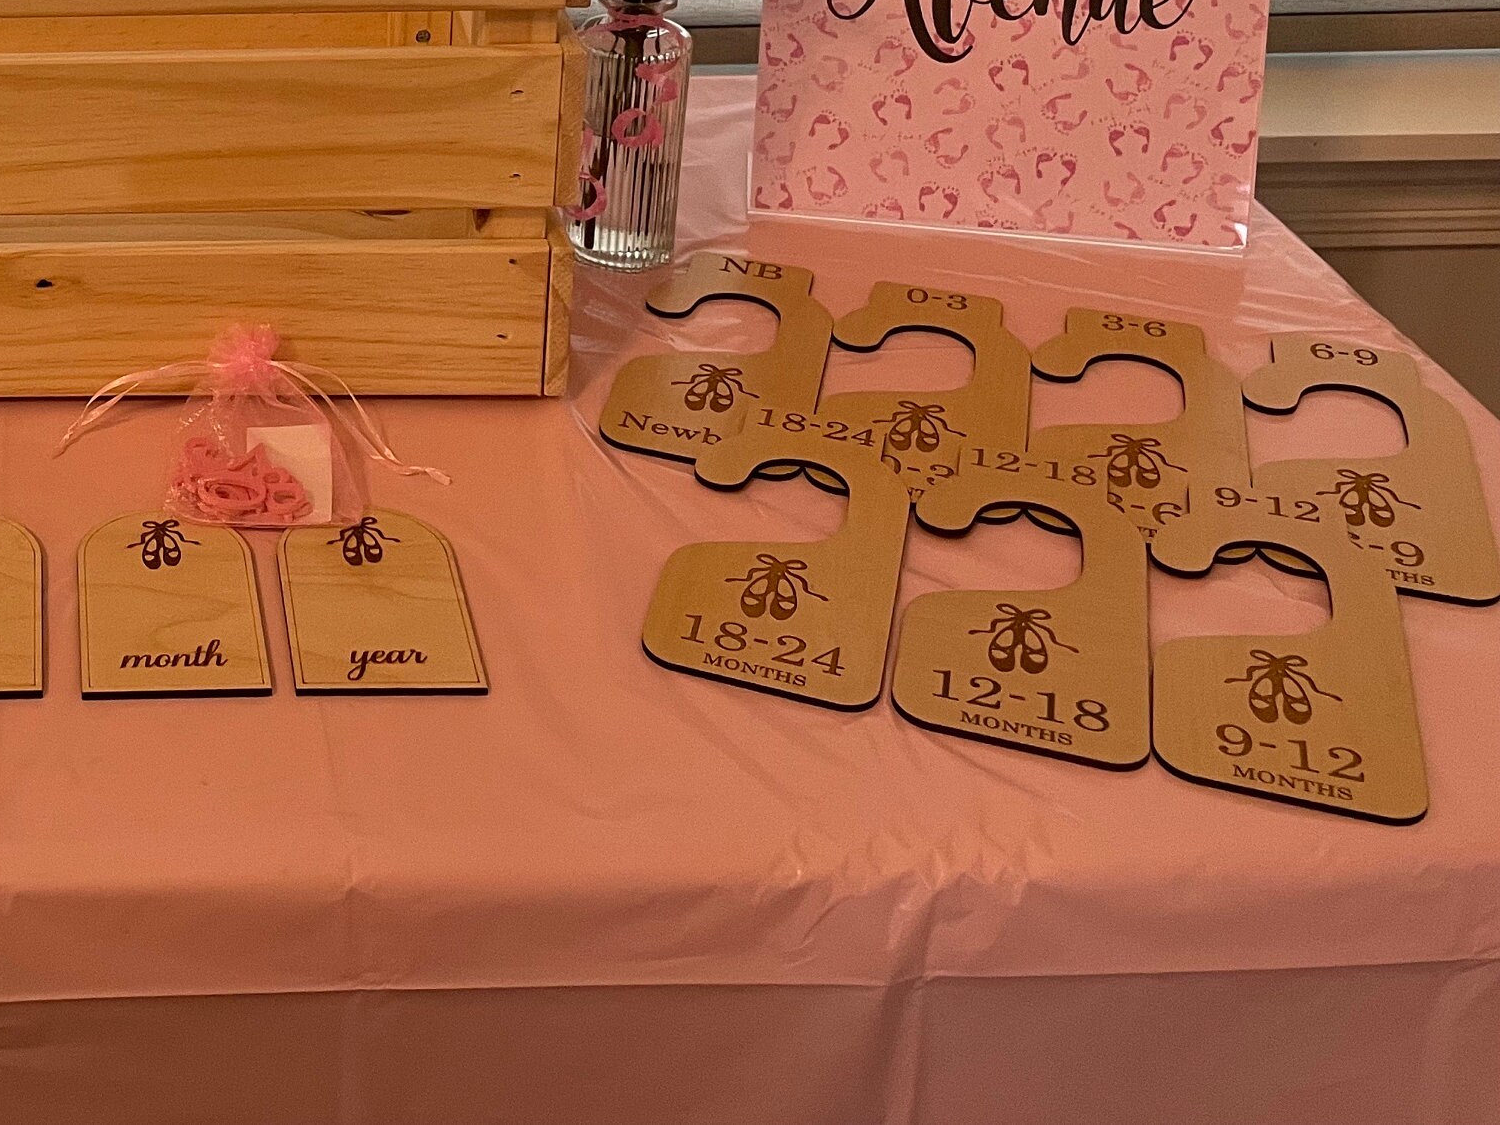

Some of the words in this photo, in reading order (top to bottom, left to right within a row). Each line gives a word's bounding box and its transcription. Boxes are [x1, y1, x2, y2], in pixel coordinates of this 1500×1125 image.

[719, 257, 783, 280] NB
[907, 288, 969, 310] 0-3
[1102, 314, 1167, 338] 3-6
[1311, 343, 1379, 366] 6-9
[756, 408, 875, 447] 18-24
[971, 448, 1097, 487] 12-18
[1215, 487, 1321, 523] 9-12
[120, 640, 228, 669] month
[679, 613, 846, 677] 18-24
[346, 647, 428, 682] year
[702, 652, 807, 688] MONTHS
[930, 669, 1111, 734] 12-18
[959, 709, 1074, 747] MONTHS
[1215, 723, 1366, 785] 9-12
[1232, 763, 1354, 801] MONTHS
